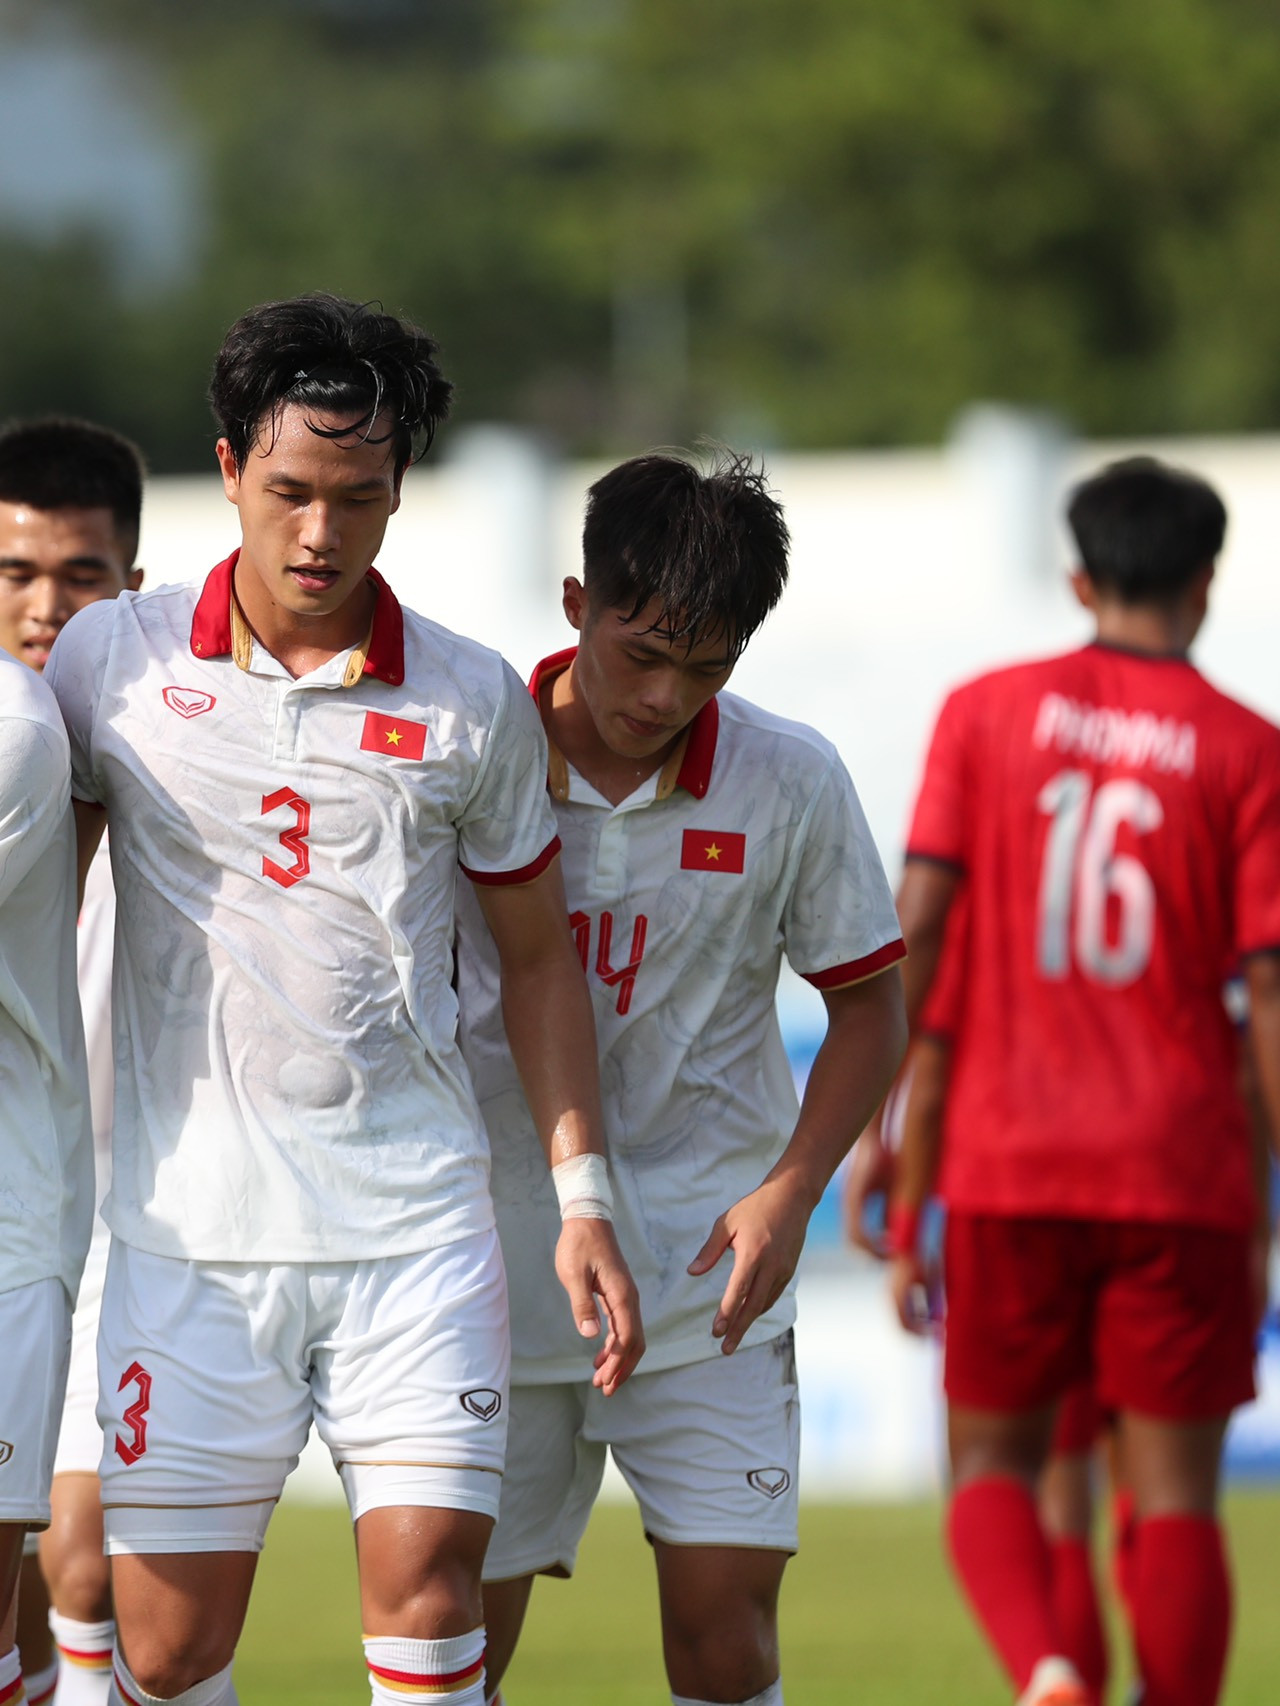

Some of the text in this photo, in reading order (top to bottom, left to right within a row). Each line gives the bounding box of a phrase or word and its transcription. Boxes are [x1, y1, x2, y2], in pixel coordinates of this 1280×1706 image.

[261, 786, 310, 888] 3
[1037, 769, 1163, 988] 16
[115, 1361, 152, 1466] 3
